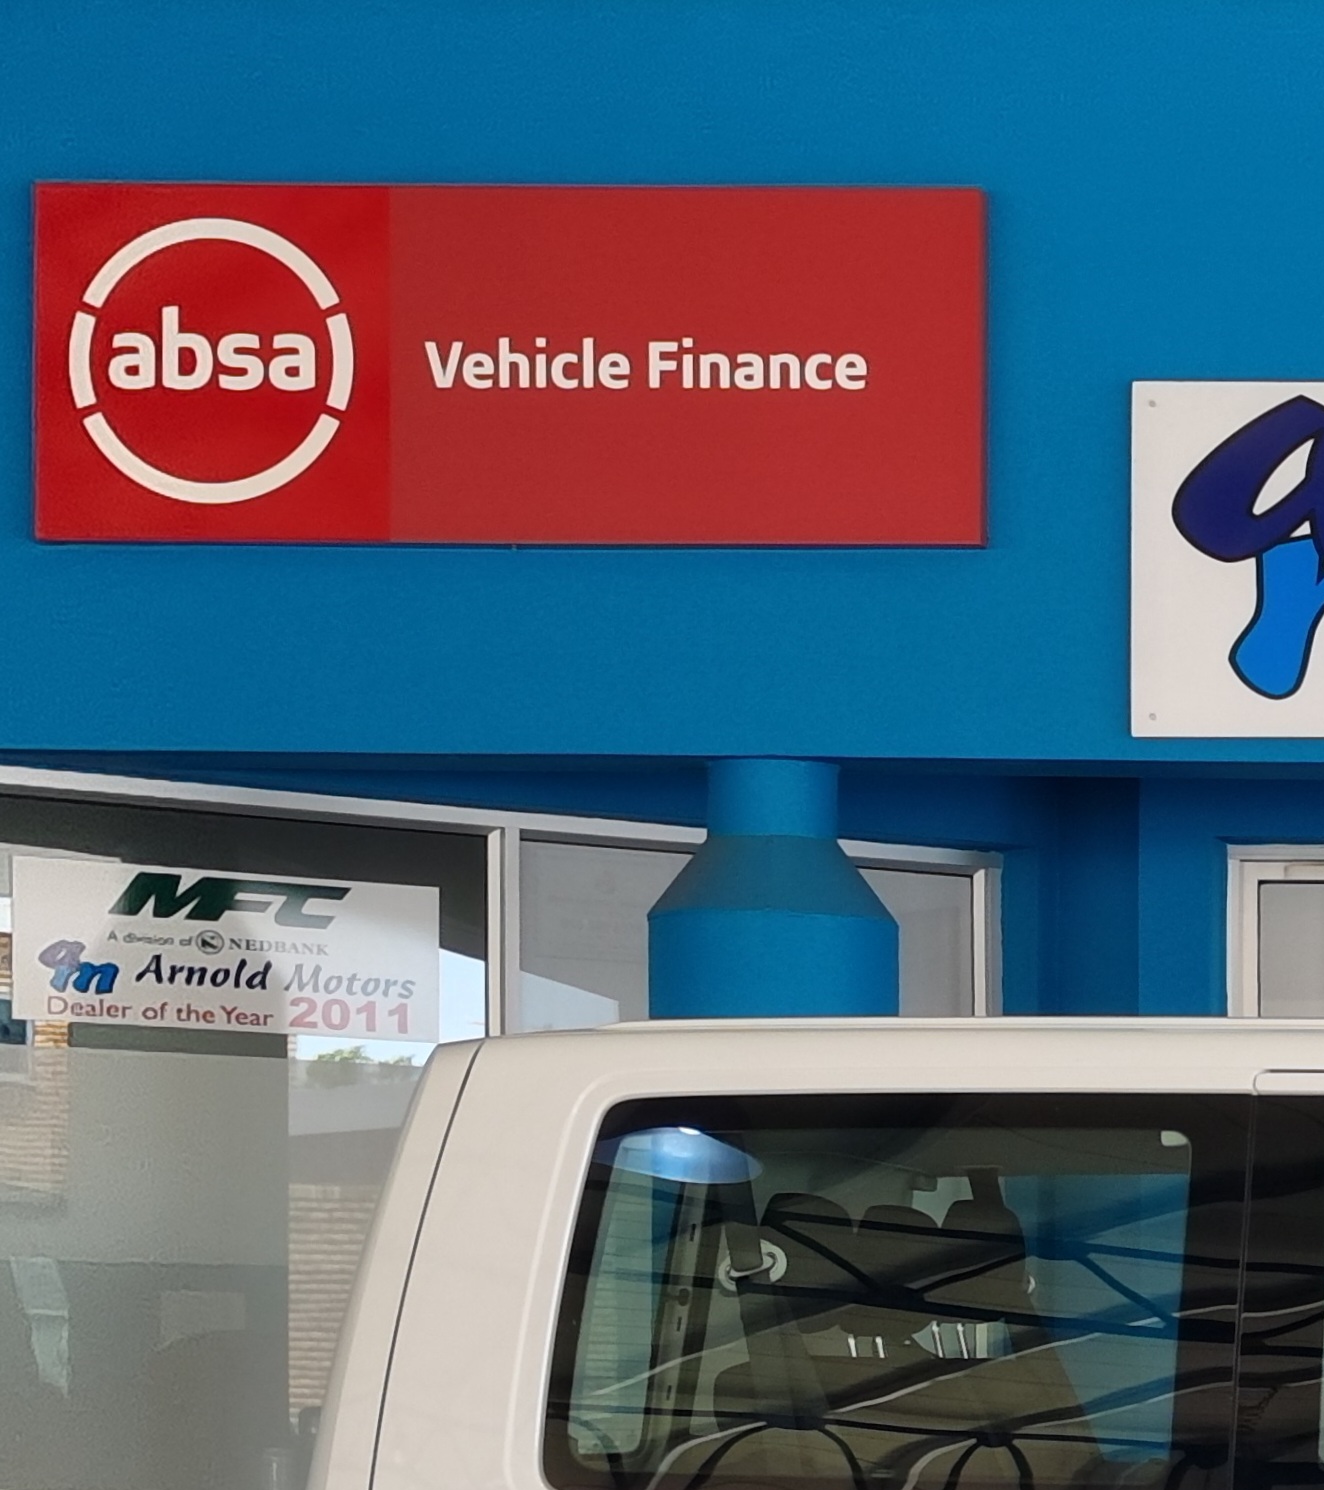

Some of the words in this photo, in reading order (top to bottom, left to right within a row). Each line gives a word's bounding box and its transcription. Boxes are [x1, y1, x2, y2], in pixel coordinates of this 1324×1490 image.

[108, 305, 316, 392] absa
[425, 336, 632, 390] Vehicle
[648, 336, 869, 390] Finance
[107, 871, 352, 930] MFC
[107, 930, 118, 942] A
[228, 937, 329, 957] NEDBANK
[135, 952, 272, 990] Arnold
[283, 962, 417, 1000] Motors
[47, 995, 133, 1019] Dealer
[141, 1001, 169, 1021] of
[176, 1002, 216, 1024] the
[220, 1004, 275, 1027] Year
[288, 996, 409, 1035] 2011
